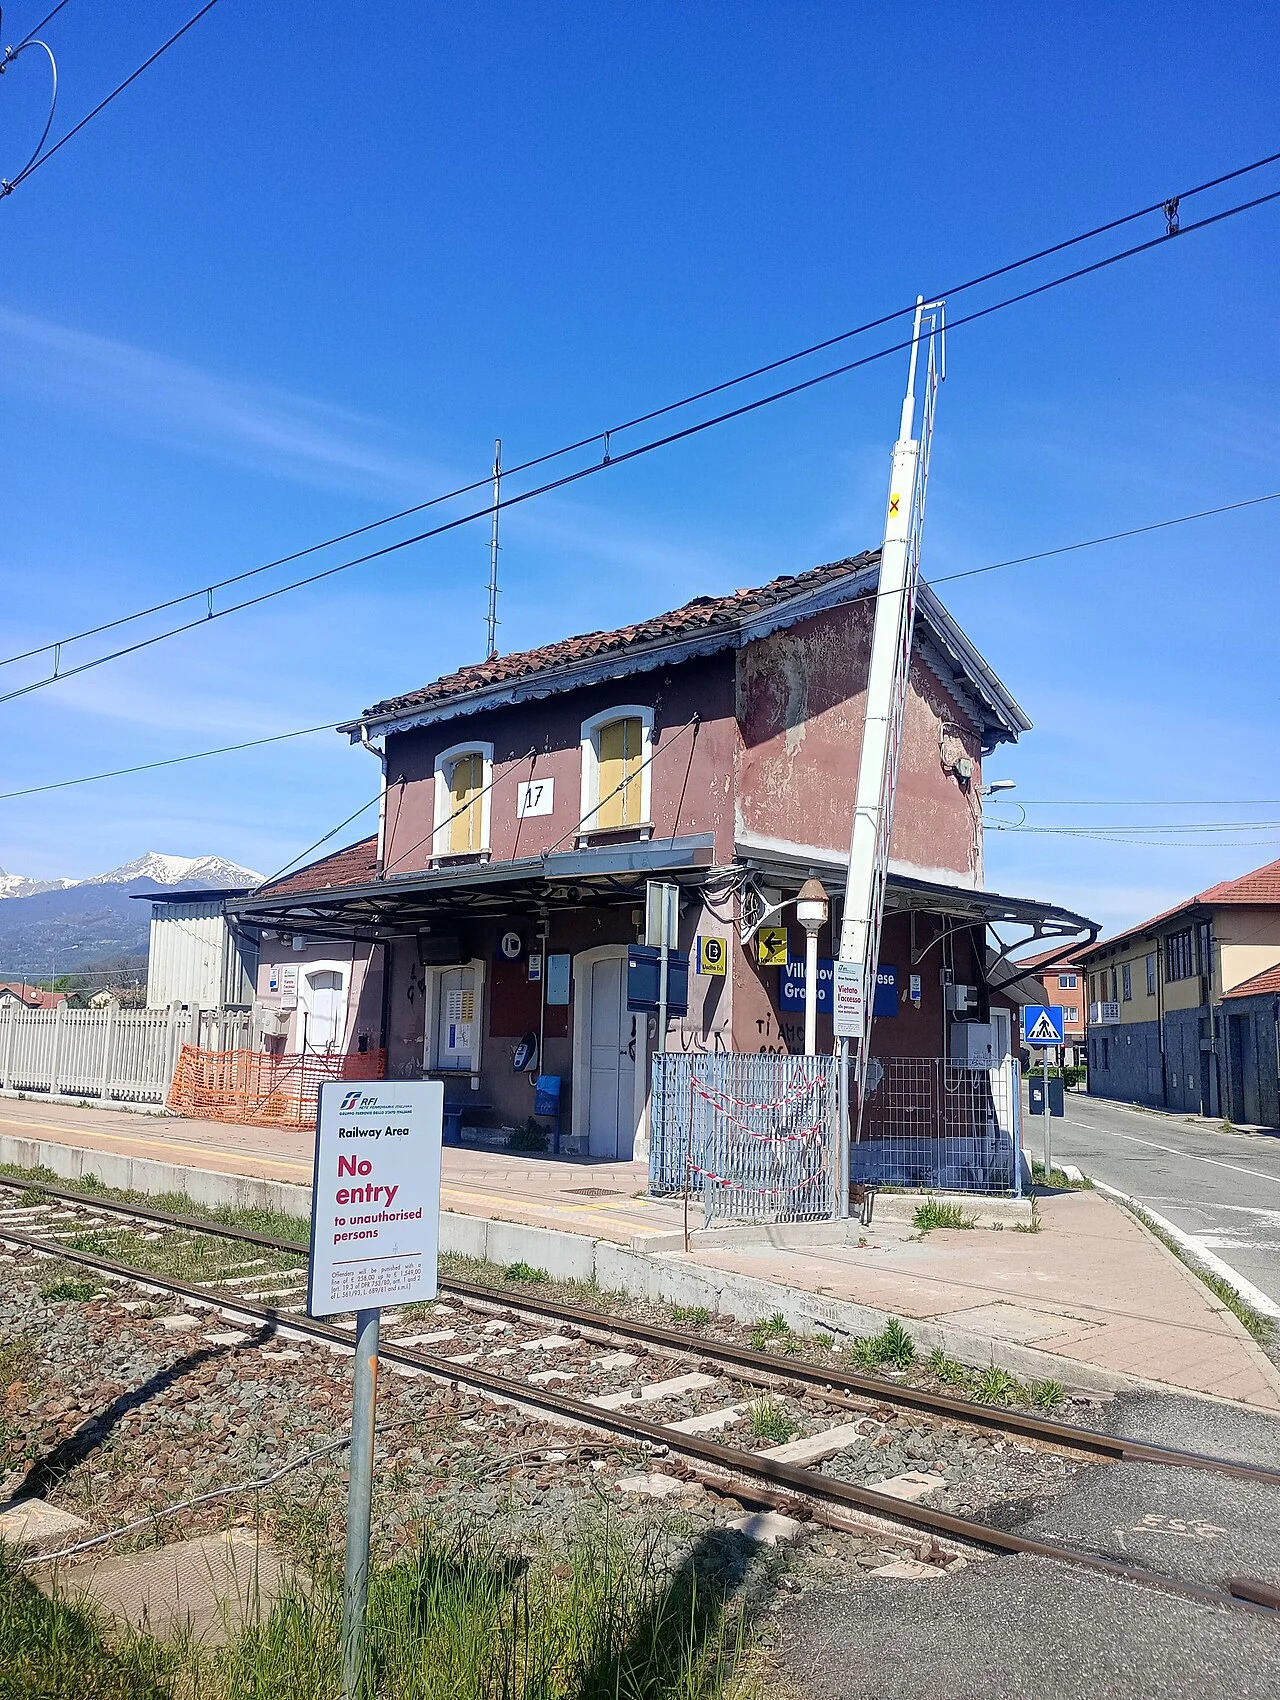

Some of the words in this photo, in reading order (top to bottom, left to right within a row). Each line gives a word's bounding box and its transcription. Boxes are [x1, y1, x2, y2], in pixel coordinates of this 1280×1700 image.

[526, 786, 544, 808] 17
[786, 962, 833, 980] Villov
[784, 982, 826, 1000] Groo
[838, 985, 858, 994] Vietato
[838, 993, 861, 1003] l'accesso
[339, 1126, 382, 1139] Railway
[385, 1126, 409, 1136] Area
[338, 1155, 372, 1177] No
[336, 1183, 399, 1207] entry
[335, 1217, 346, 1226] to
[350, 1207, 422, 1225] unauthorised
[334, 1230, 378, 1245] persons
[332, 1270, 354, 1278] Offenders
[381, 1264, 400, 1272] punished
